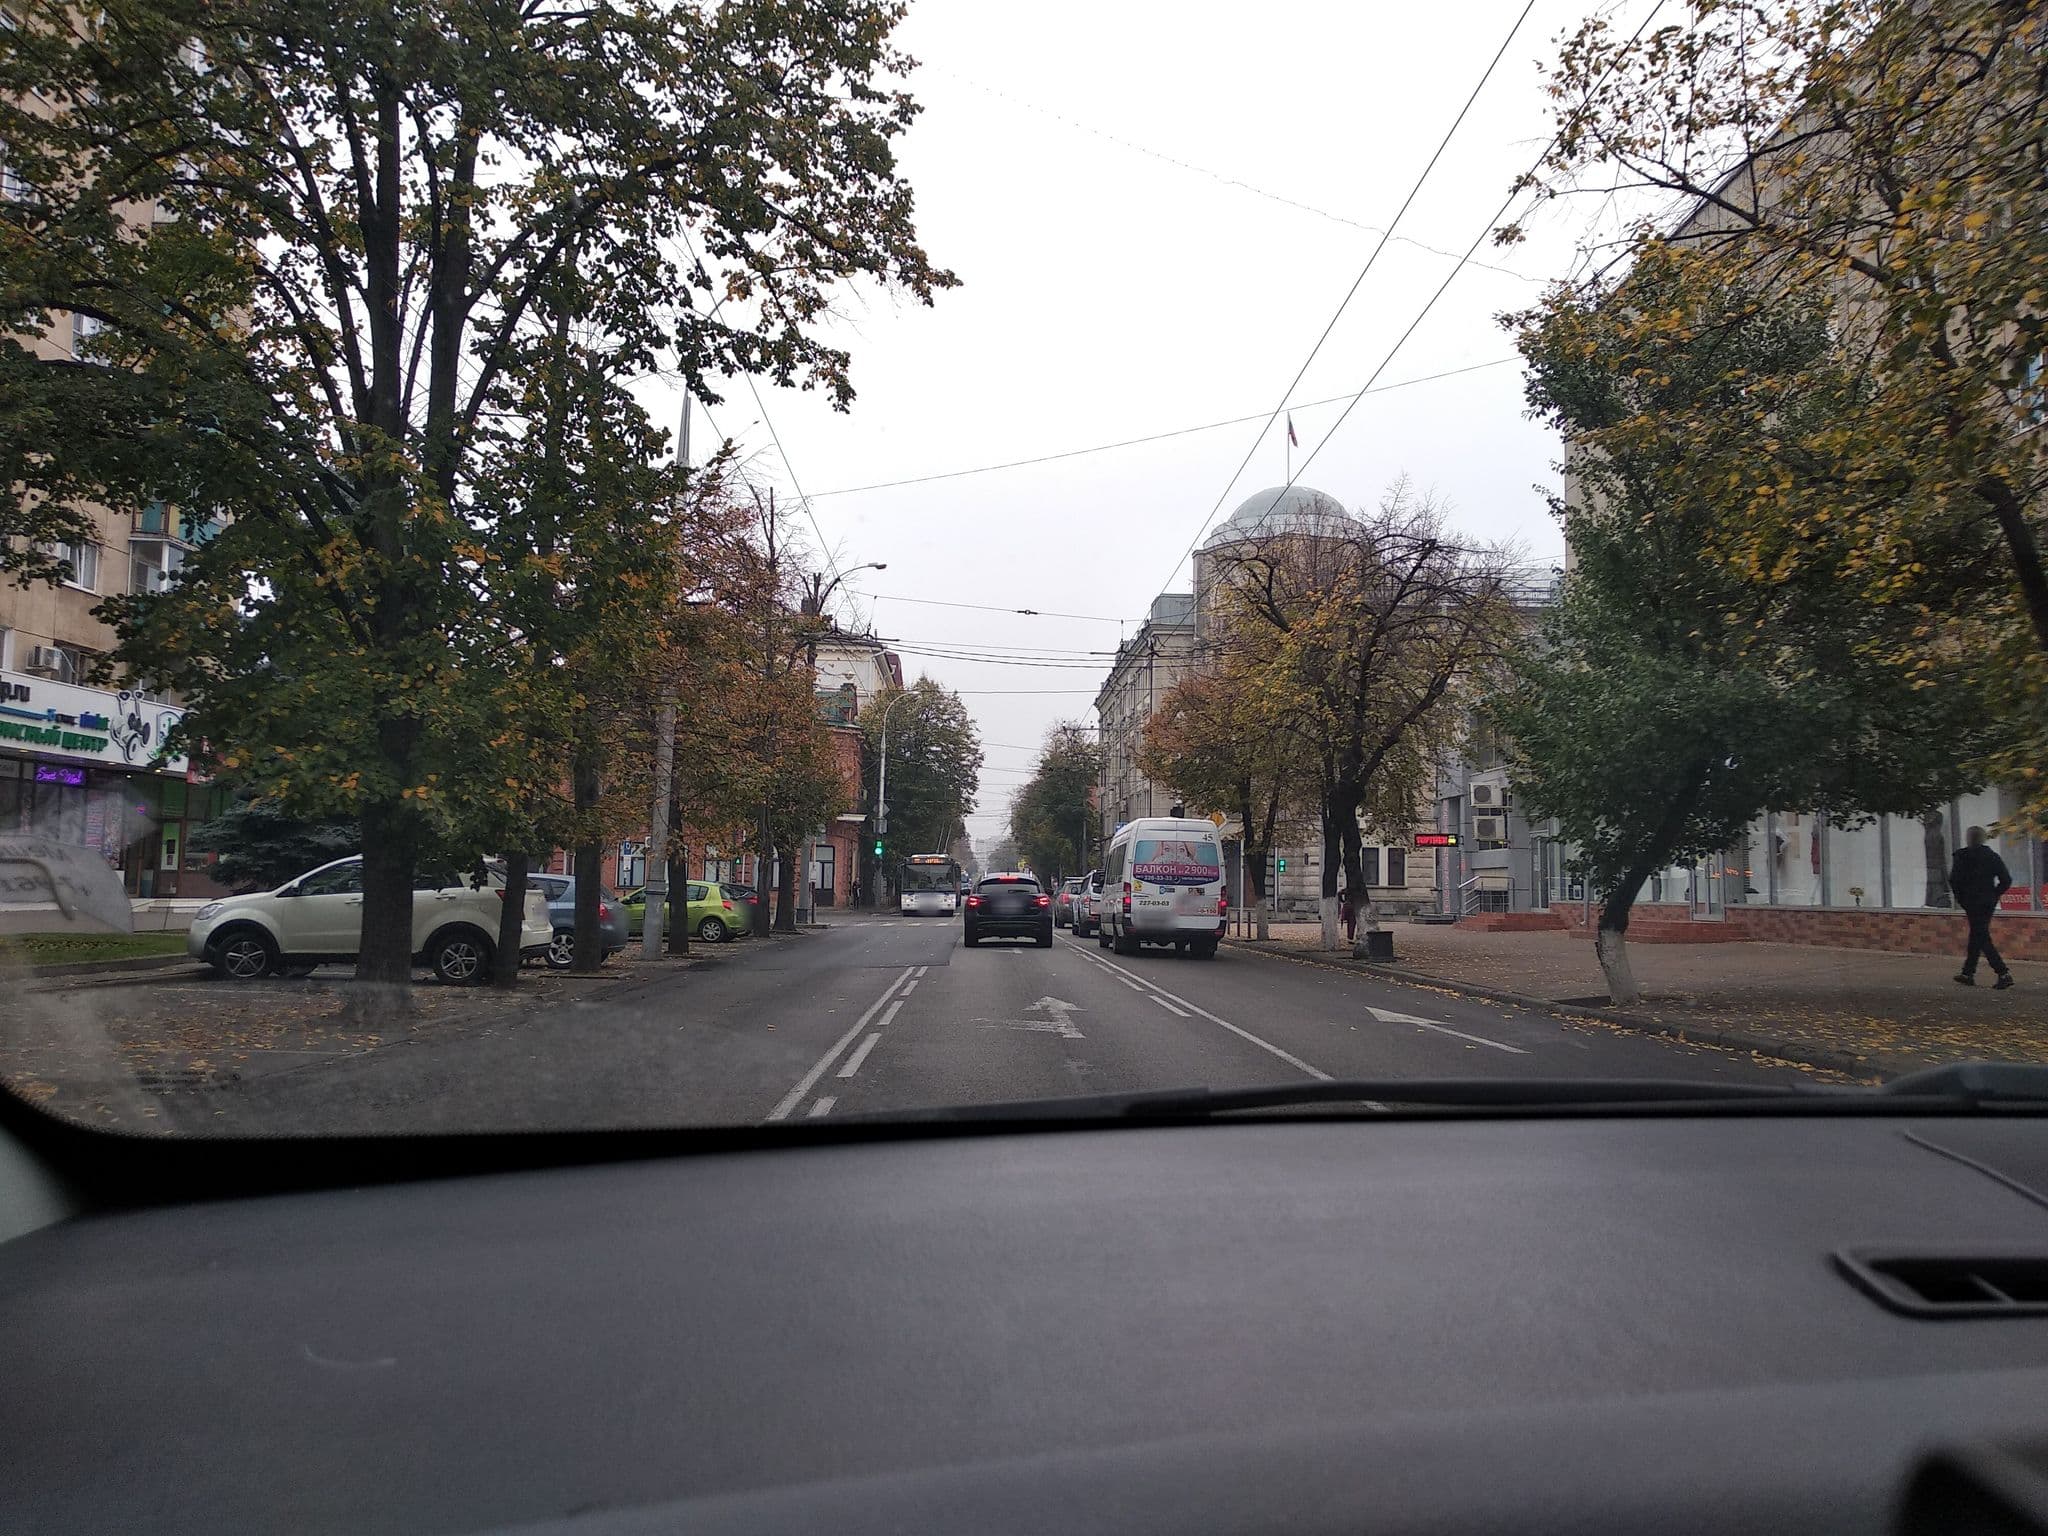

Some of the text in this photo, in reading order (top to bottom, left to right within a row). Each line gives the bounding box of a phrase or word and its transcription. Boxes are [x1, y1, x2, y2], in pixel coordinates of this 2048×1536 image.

[1202, 834, 1214, 842] 45
[1135, 864, 1176, 873] БАЛКОН
[1184, 866, 1208, 875] 2900
